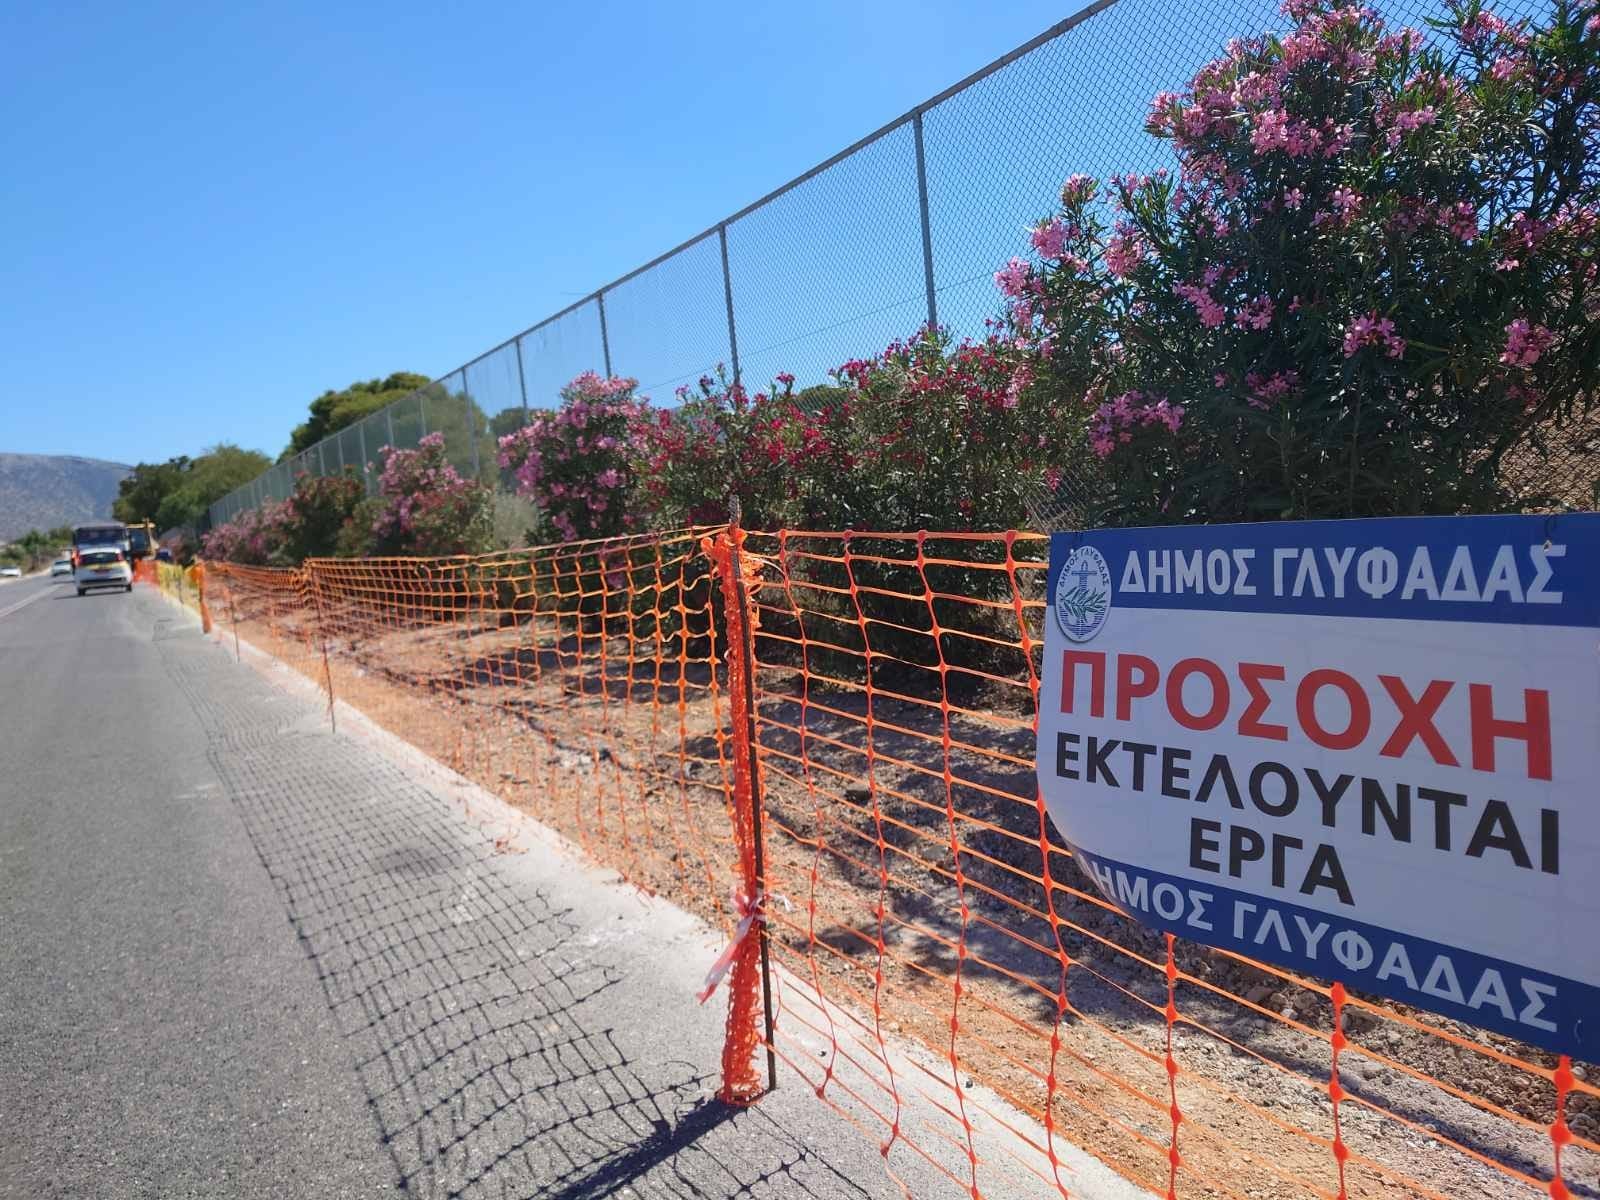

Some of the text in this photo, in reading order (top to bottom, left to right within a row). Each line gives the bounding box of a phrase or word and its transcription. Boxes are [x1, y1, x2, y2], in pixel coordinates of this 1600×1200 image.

[1119, 544, 1567, 604] ΔΗΜΟΣ ΓΛΥΦΑΔΑΣ
[1060, 650, 1553, 781] ΠΡΟΣΟΧΗ
[1056, 731, 1560, 875] ΕΚΤΕΛΟΥΝΤΑΙ
[1189, 817, 1356, 906] ΕΡΓΑ
[1232, 901, 1559, 1033] ΓΛΥΦΑΔΑΣ
